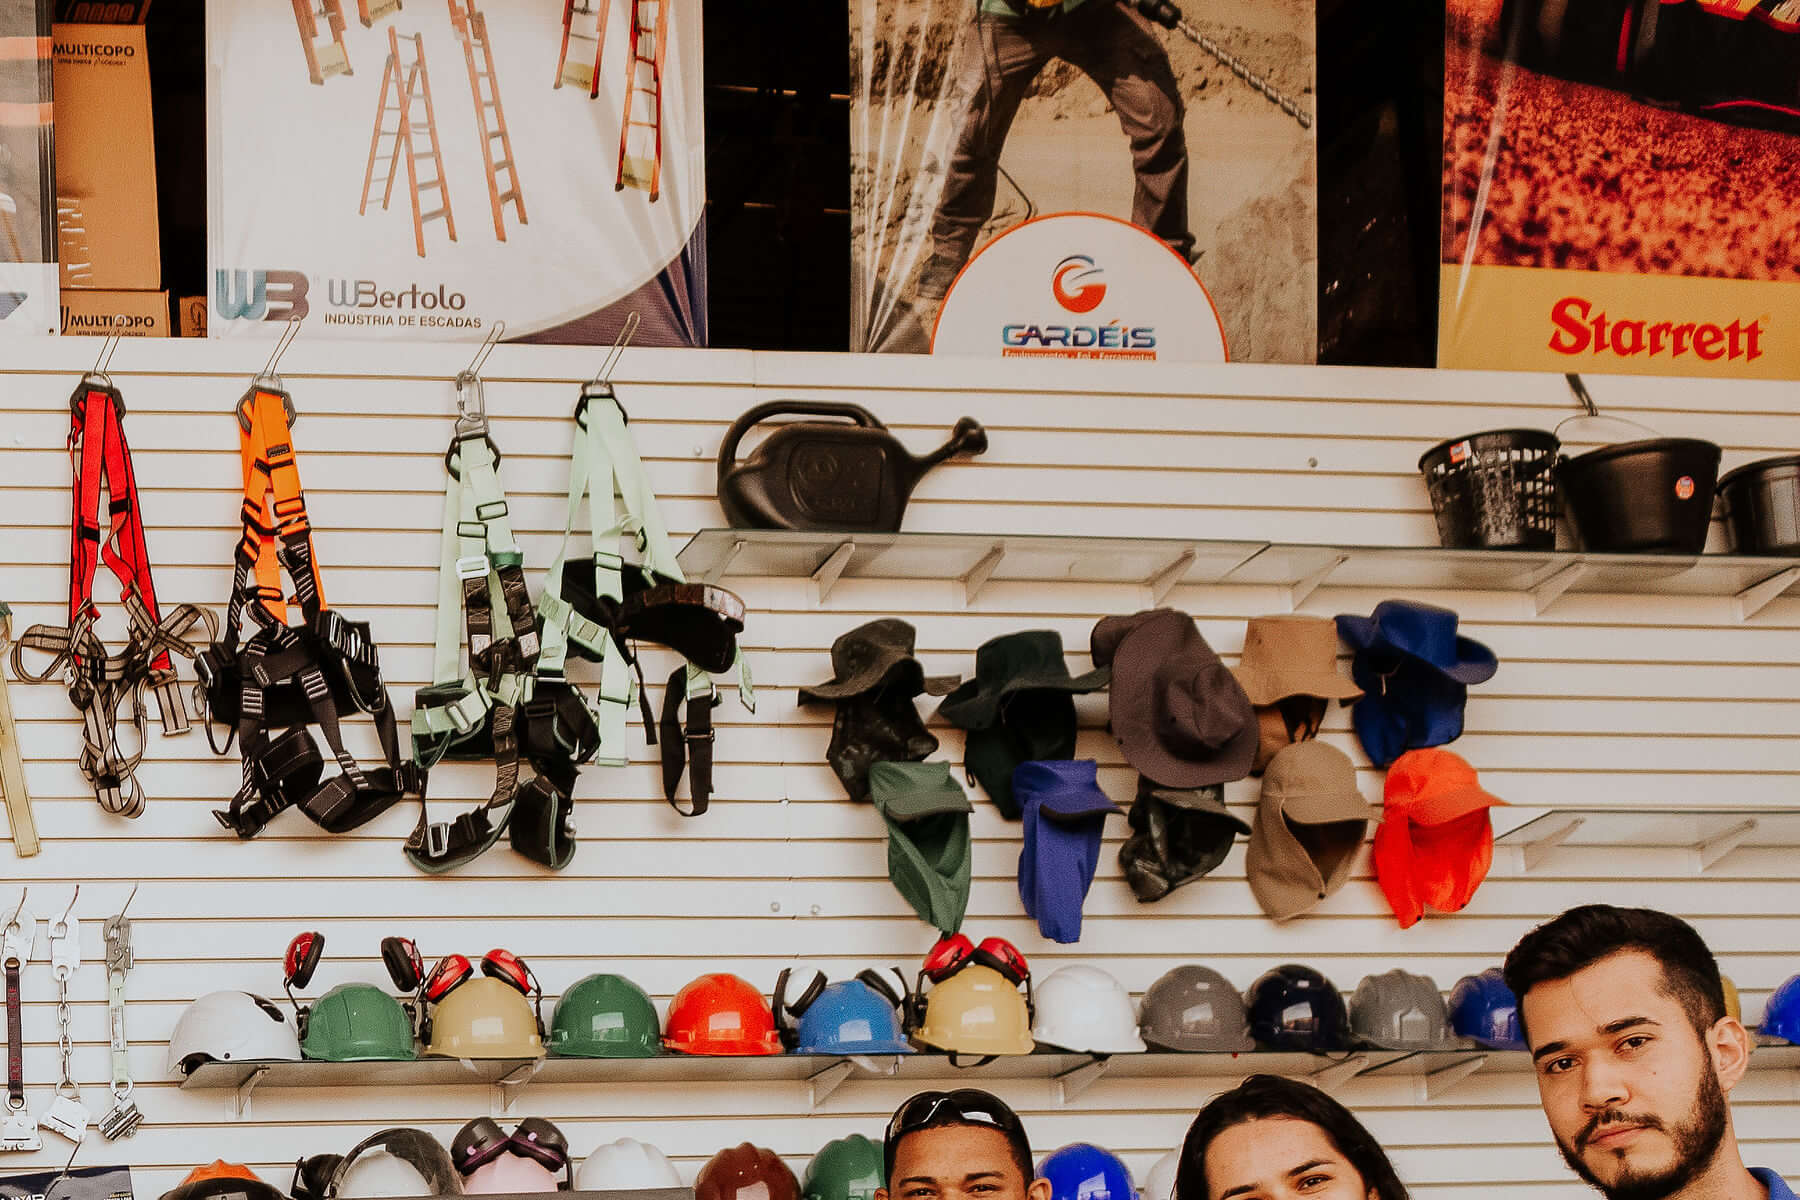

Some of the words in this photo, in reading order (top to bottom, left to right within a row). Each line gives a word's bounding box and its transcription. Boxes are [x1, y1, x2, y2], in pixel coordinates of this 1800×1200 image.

[52, 44, 135, 57] MULTICOPO
[324, 312, 394, 327] INDÚSTRIA
[398, 315, 416, 326] DE
[420, 316, 482, 328] ESCADAS
[1548, 296, 1764, 362] Starrett
